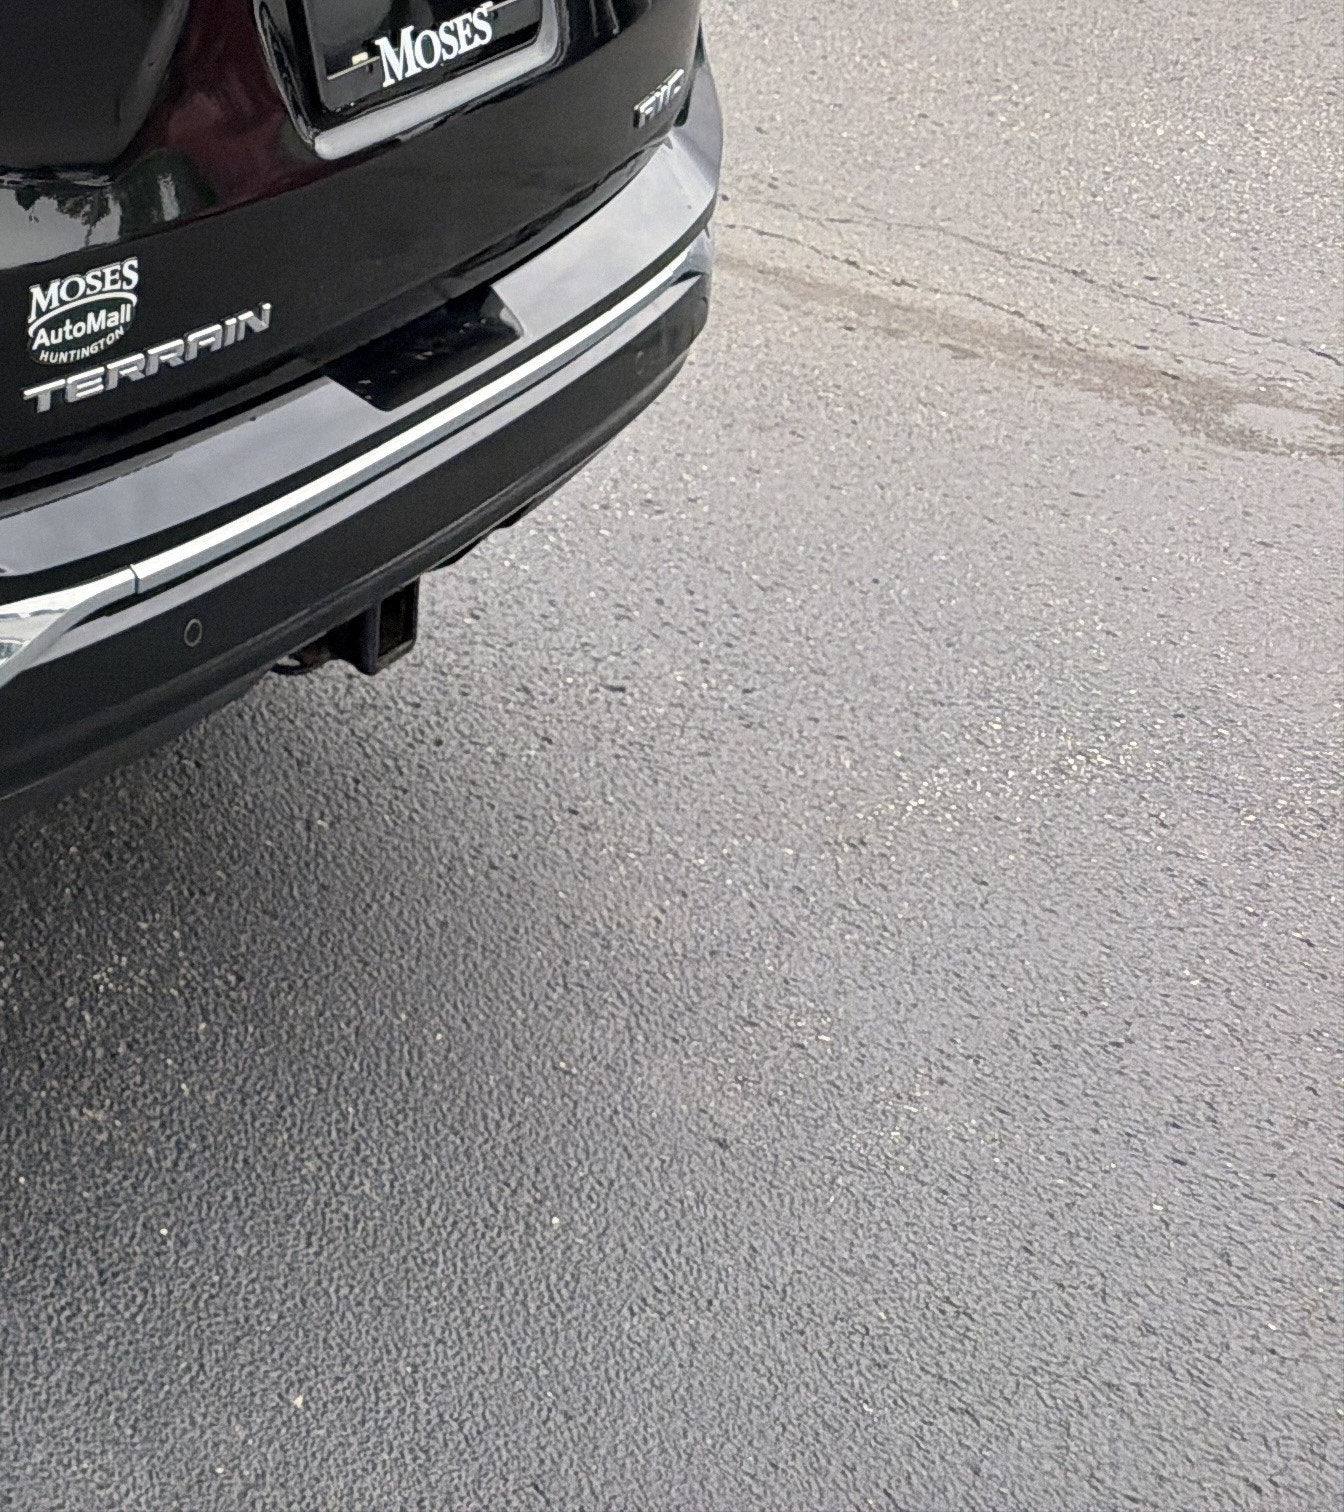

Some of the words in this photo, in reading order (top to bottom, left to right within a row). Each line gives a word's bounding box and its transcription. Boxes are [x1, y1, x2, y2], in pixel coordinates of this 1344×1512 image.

[374, 0, 494, 88] MOSES
[27, 255, 140, 324] MOSES
[22, 301, 273, 414] TERRAIN
[31, 302, 133, 351] AutoMall
[38, 325, 126, 365] HUNTINGTON
